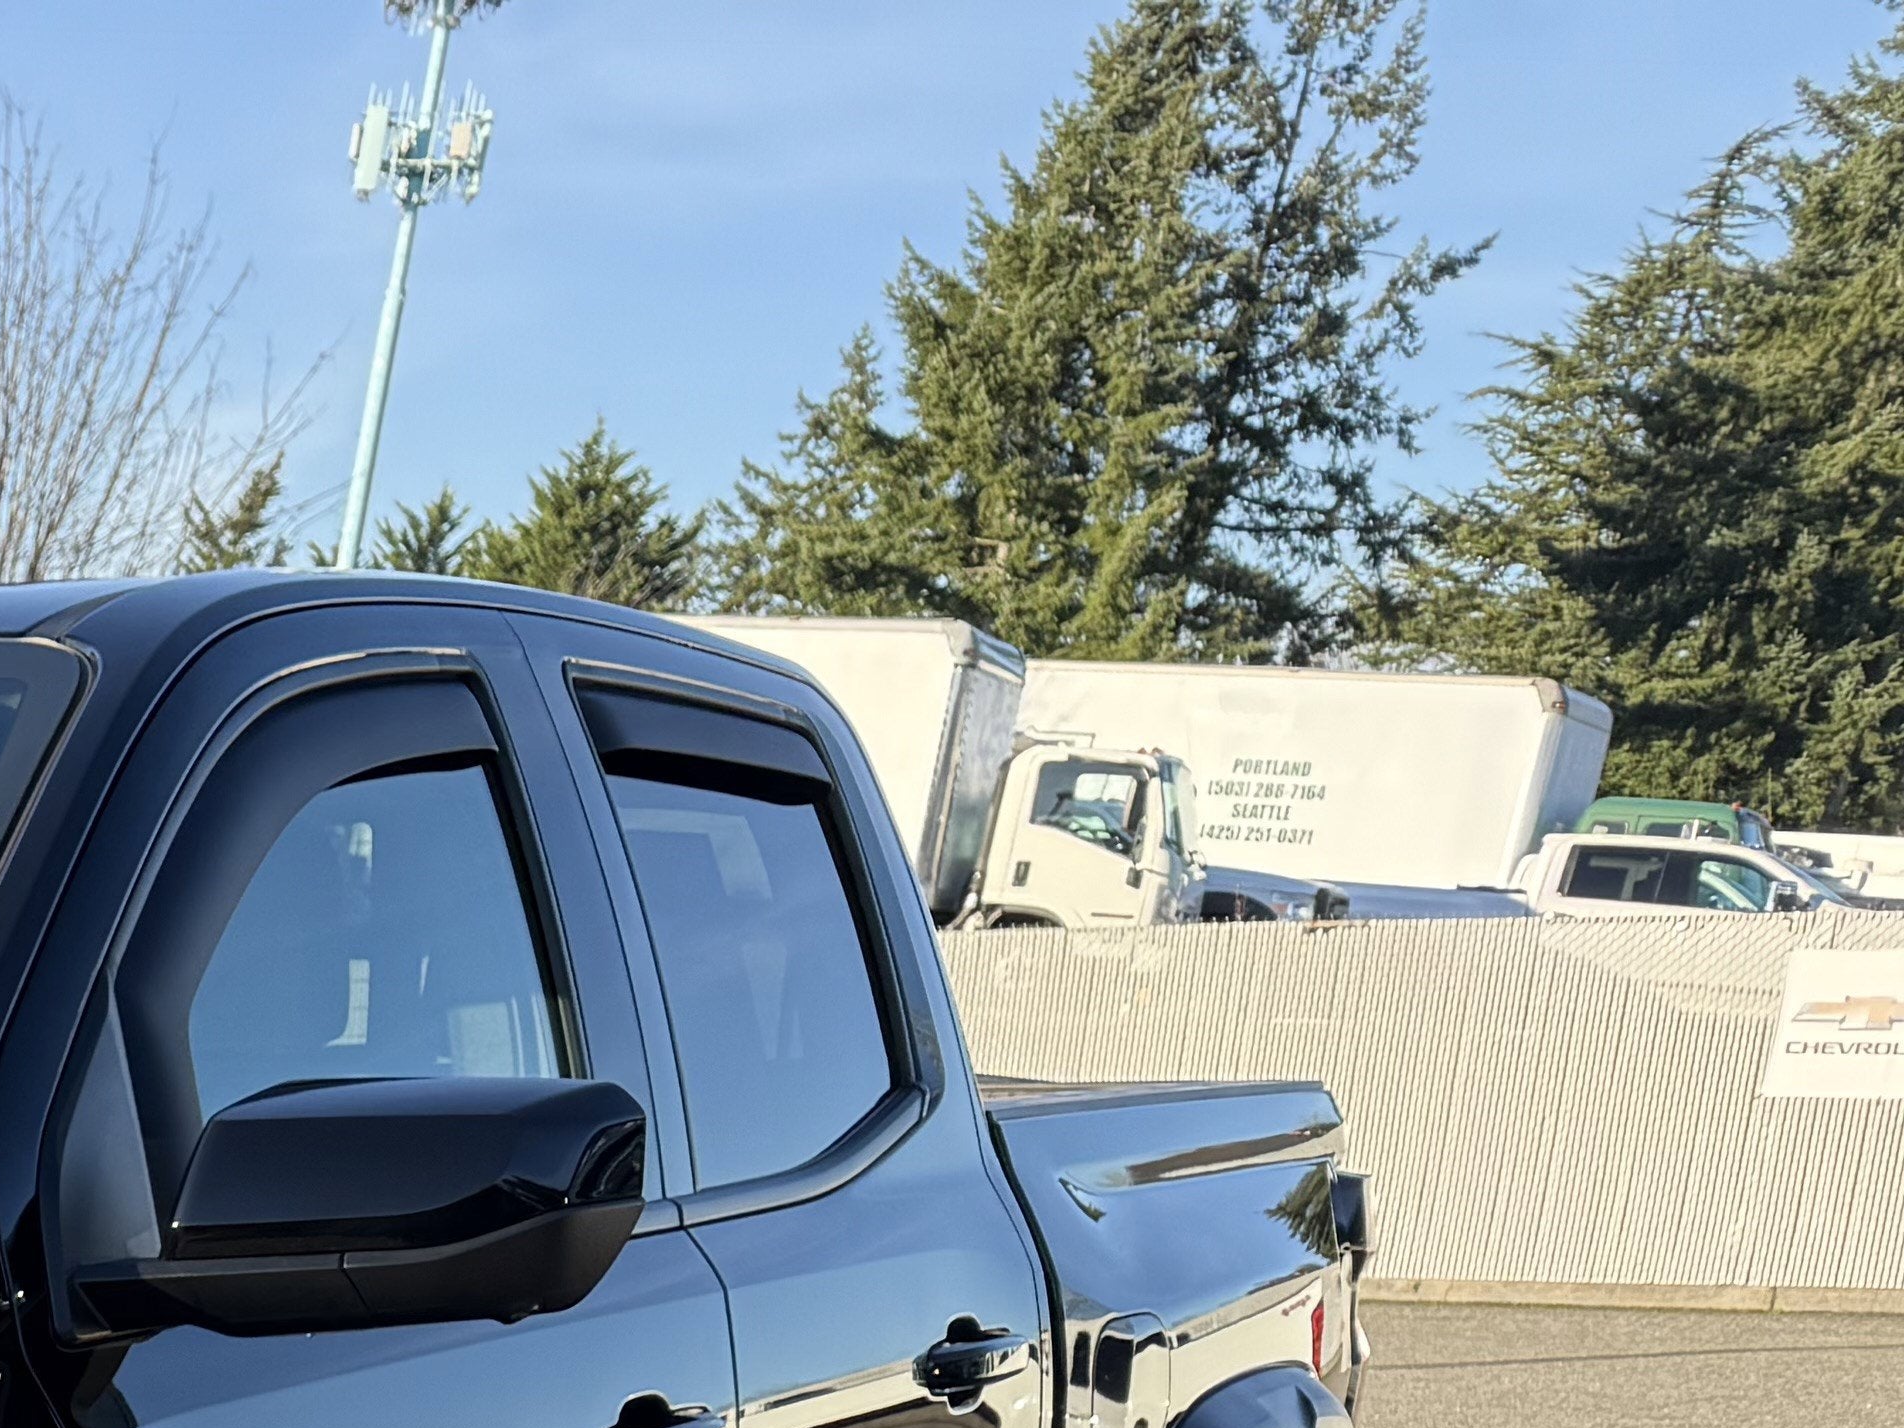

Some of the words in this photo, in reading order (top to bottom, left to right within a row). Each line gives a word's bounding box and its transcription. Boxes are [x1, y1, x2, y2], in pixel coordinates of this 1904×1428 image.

[1233, 758, 1312, 776] PORTLAND
[1207, 780, 1252, 798] (503)
[1231, 803, 1292, 820] SEATTLE
[1199, 823, 1242, 841] (425)
